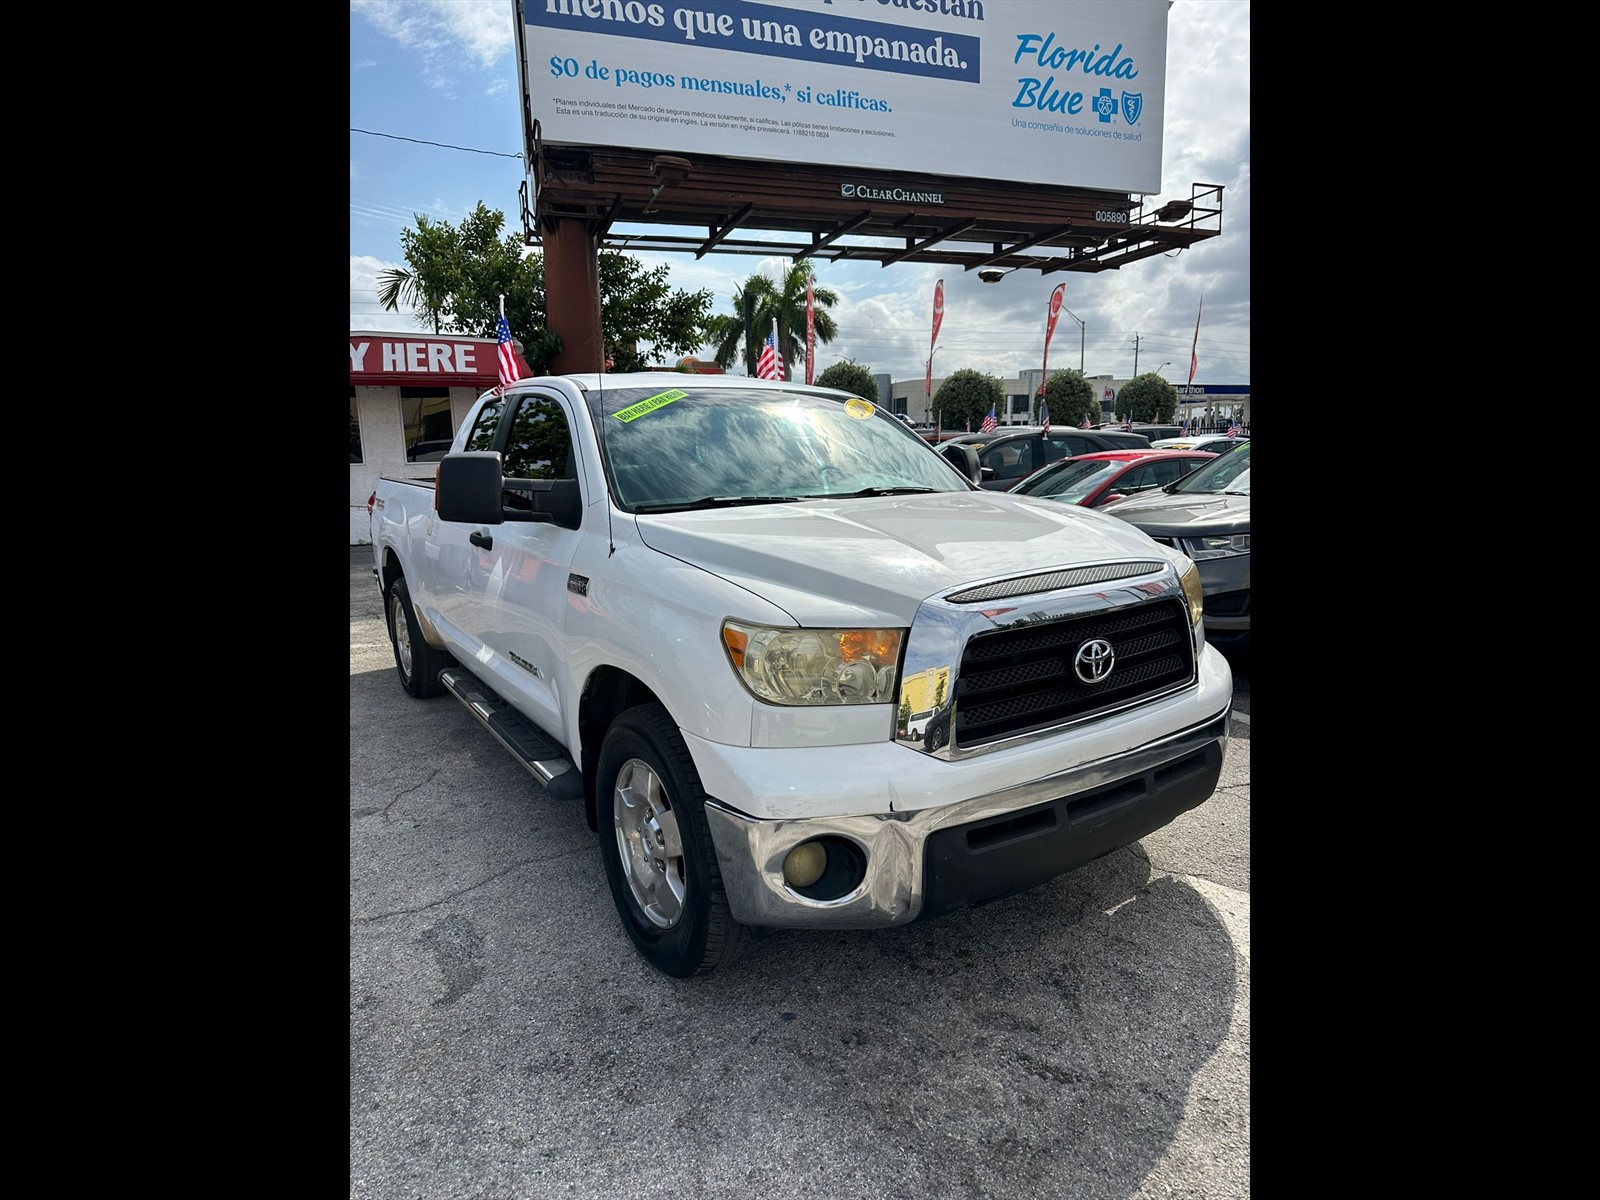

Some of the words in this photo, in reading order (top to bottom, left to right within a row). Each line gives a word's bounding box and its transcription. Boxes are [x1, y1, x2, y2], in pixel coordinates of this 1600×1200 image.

[546, 0, 665, 27] menos
[673, 8, 734, 40] que
[741, 18, 802, 46] una
[809, 28, 967, 69] empanada.
[1014, 32, 1139, 80] Florida
[550, 55, 579, 79] $0
[585, 60, 610, 80] de
[615, 68, 675, 88] pagos
[797, 86, 812, 103] si
[816, 89, 893, 113] calificas.
[1012, 76, 1083, 115] Blue
[556, 107, 571, 115] Esta
[594, 110, 628, 119] traducción
[647, 115, 670, 123] original
[579, 100, 616, 109] individuales
[628, 104, 655, 112] Mercado
[666, 108, 690, 116] seguros
[691, 111, 716, 119] médicos
[792, 121, 811, 129] pólizas
[812, 123, 828, 131] tienen
[829, 125, 860, 134] limitaciones
[1012, 118, 1027, 129] Una
[1064, 124, 1074, 133] de
[1075, 127, 1112, 139] soluciones
[1113, 131, 1122, 139] de
[1123, 133, 1142, 142] salud
[1095, 210, 1127, 223] 005890
[382, 342, 477, 373] HERE
